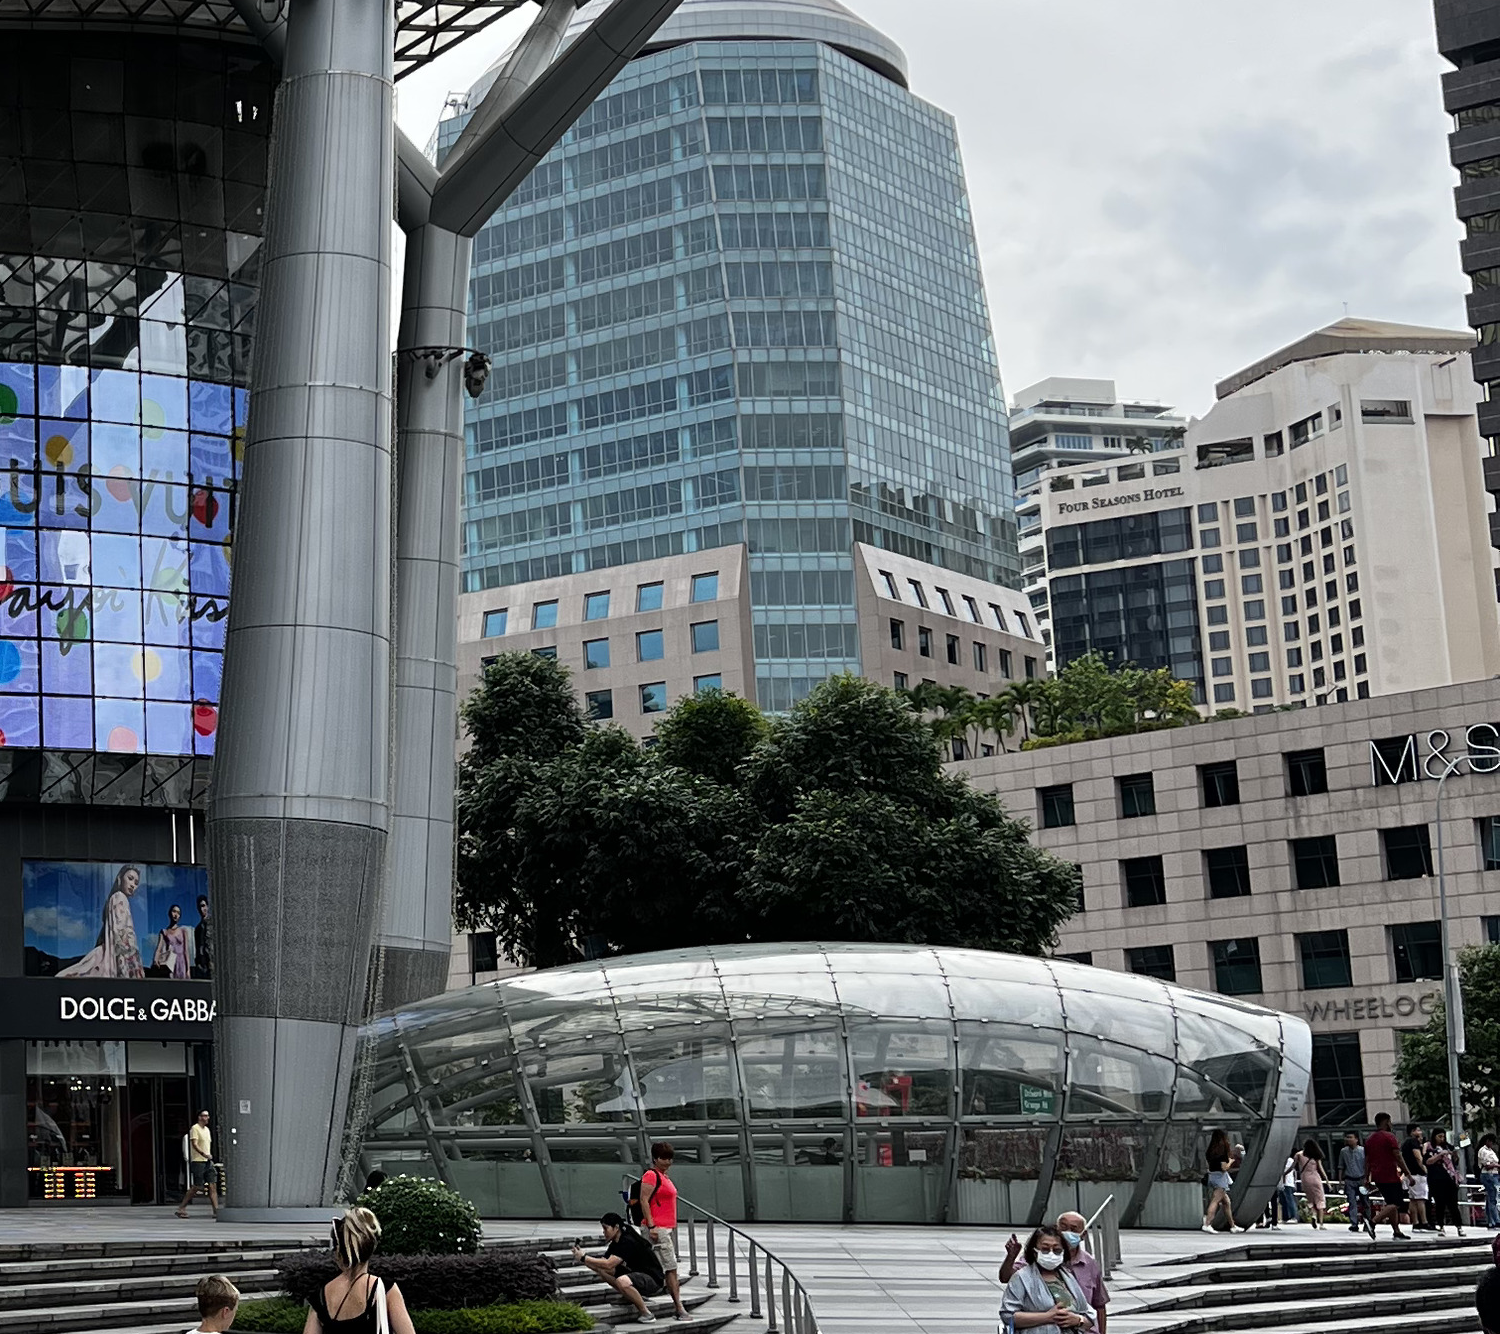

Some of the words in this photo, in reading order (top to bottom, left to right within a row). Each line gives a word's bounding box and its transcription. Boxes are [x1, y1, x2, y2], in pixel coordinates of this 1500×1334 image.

[1057, 501, 1089, 514] FOUR
[1092, 493, 1141, 508] SEASONS
[1143, 486, 1184, 501] HOTEL
[1369, 723, 1500, 786] M&S
[60, 996, 136, 1021] DOLCE
[137, 1008, 148, 1021] &
